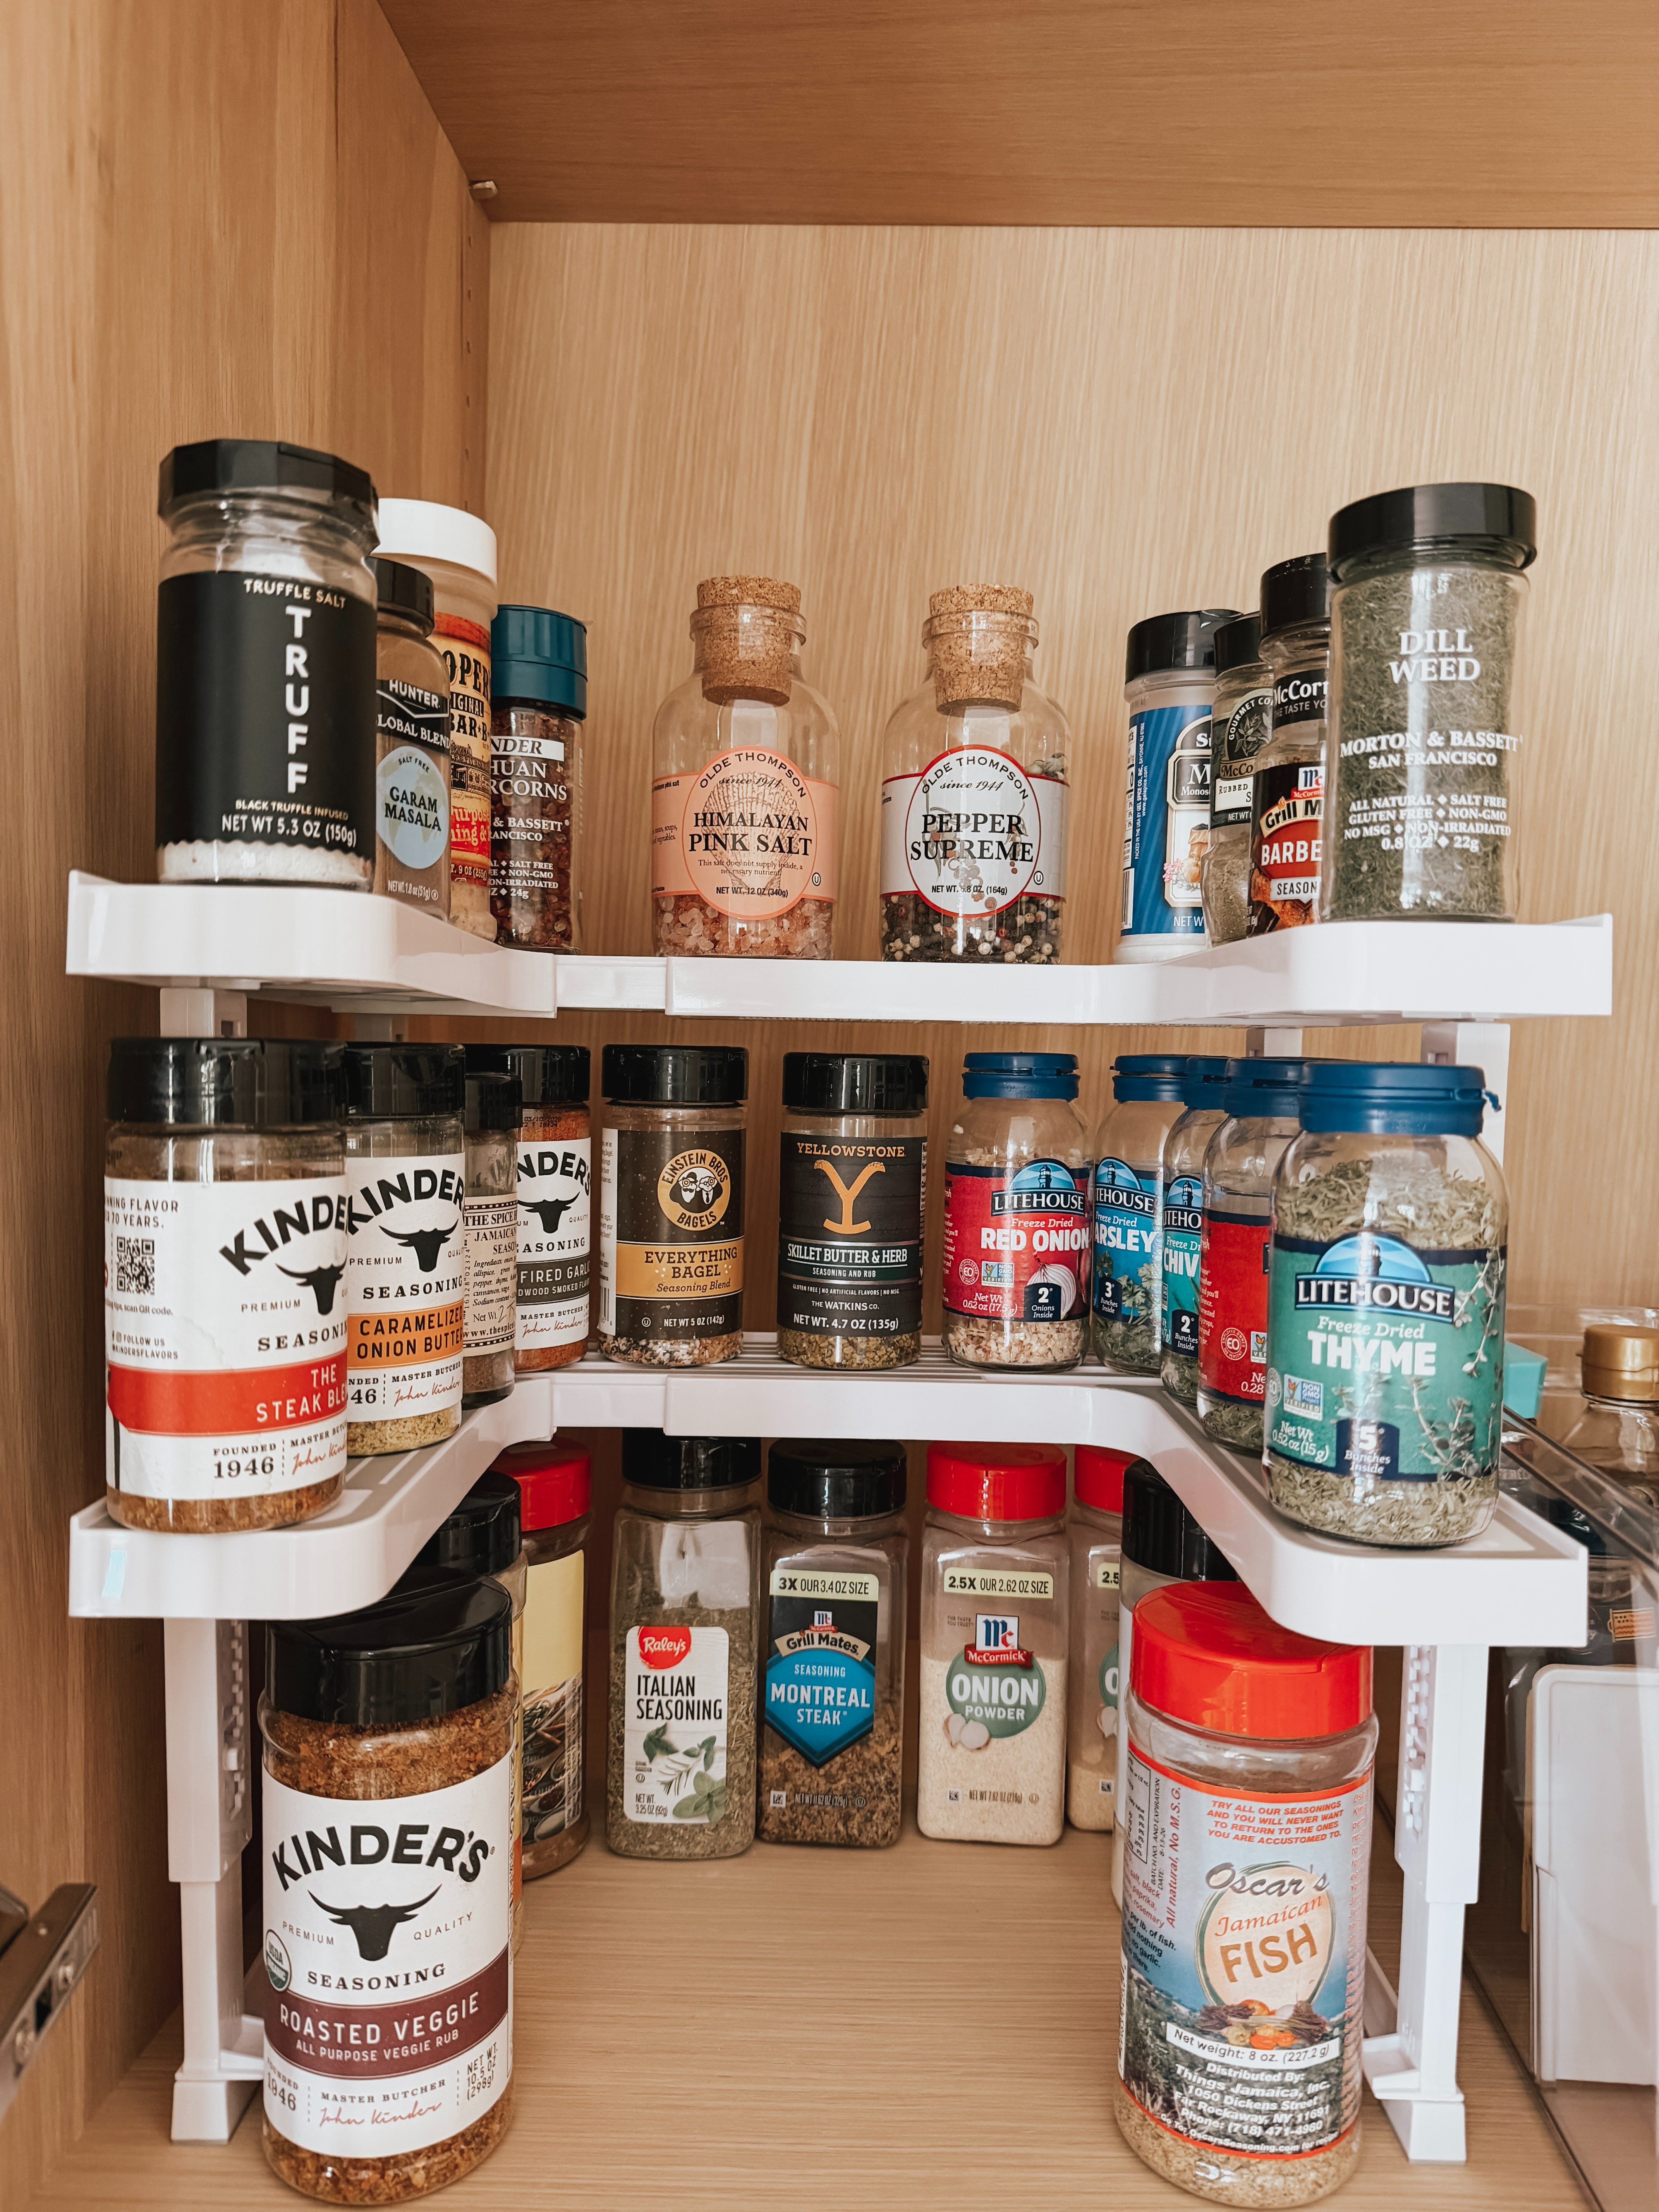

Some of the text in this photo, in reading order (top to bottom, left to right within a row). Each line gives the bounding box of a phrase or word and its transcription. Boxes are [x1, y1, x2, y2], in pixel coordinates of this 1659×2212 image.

[244, 579, 346, 608] TRUFFLE SALT
[1399, 629, 1473, 655] DILL
[1389, 658, 1481, 684] WEED
[389, 680, 438, 708] HUNTER
[1285, 701, 1310, 714] TASTE
[1229, 700, 1255, 740] GOURMET
[1341, 731, 1518, 758] MORTON & BASSETT
[398, 756, 430, 773] SALT FREE
[1369, 751, 1497, 769] SAN FRANCISCO
[700, 752, 806, 798] OLDE THOMPSON
[922, 756, 1028, 800] OLDE THOMPSON
[1219, 783, 1248, 794] RUBBED
[235, 799, 348, 821] BLACK TRUFFLE INFUSED
[390, 786, 437, 813] GARAM
[385, 802, 441, 832] MASALA
[493, 817, 563, 832] & BASSETT
[694, 812, 808, 831] HIMALAYAN
[922, 813, 1024, 834] PEPPER
[1265, 801, 1297, 828] Grill
[689, 833, 812, 856] PINK SALT
[911, 840, 1033, 862] SUPREME
[508, 869, 553, 879] NON-GMO
[779, 861, 798, 870] iodide,
[510, 888, 529, 899] 24g
[768, 888, 788, 898] (340g)
[797, 1143, 905, 1158] YELLOWSTONE
[662, 1153, 728, 1184] EINSTEIN BROS
[131, 1199, 178, 1212] FLAVOR
[995, 1193, 1084, 1211] LITEHOUSE
[465, 1211, 513, 1226] THE SPICE
[677, 1211, 718, 1228] BAGELS
[1011, 1217, 1073, 1228] Freeze Dried
[981, 1227, 1089, 1252] RED ONION
[645, 1247, 737, 1264] EVERYTHING
[788, 1244, 907, 1264] SKILLET BUTTER & HERB
[520, 1267, 562, 1283] FIRED
[672, 1264, 721, 1278] BAGEL
[813, 1267, 876, 1278] SEASONING AND RUB
[363, 1276, 462, 1300] SEASONING
[657, 1279, 730, 1293] Seasoning Blend
[825, 1301, 868, 1311] WATKINS
[1101, 1297, 1118, 1307] Bunches
[1298, 1280, 1450, 1315] LITEHOUSE
[1102, 1304, 1115, 1314] Inside
[359, 1305, 462, 1336] CARAMELIZED
[1317, 1316, 1425, 1339] Freeze Dried
[124, 1333, 165, 1346] FOLLOW US
[357, 1328, 463, 1358] ONION BUTTER
[1175, 1332, 1198, 1344] Bunches
[1177, 1341, 1194, 1351] Inside
[1308, 1331, 1436, 1376] THYME
[311, 1364, 337, 1388] THE
[256, 1393, 321, 1422] STEAK
[213, 1443, 276, 1456] FOUNDED
[1344, 1450, 1390, 1463] Bunches
[213, 1456, 274, 1478] 1946
[1350, 1462, 1383, 1474] Inside
[778, 1577, 869, 1595] 3X OUR 3.4 OZ SIZE
[643, 1636, 686, 1656] Raley's
[967, 1650, 1024, 1662] McCormick
[794, 1664, 845, 1677] SEASONING
[637, 1674, 696, 1697] ITALIAN
[771, 1683, 870, 1708] MONTREAL
[951, 1673, 1038, 1705] ONION
[636, 1699, 722, 1721] SEASONING
[797, 1709, 841, 1725] STEAK
[965, 1705, 1025, 1720] POWDER
[1207, 1809, 1344, 1825] AND YOU WILL NEVER WANT
[1212, 1800, 1232, 1809] TRY
[1235, 1805, 1254, 1813] ALL
[1284, 1801, 1341, 1815] SEASONINGS
[272, 1824, 489, 1892] KINDER'S
[1166, 1787, 1181, 1929] All natural, No M.S.G.
[1206, 1862, 1329, 1896] Oscar's
[1214, 1895, 1323, 1936] Jamaican
[282, 1912, 473, 1946] PREMIUM QUALITY
[1220, 1922, 1317, 1983] FISH
[307, 1962, 447, 1991] SEASONING
[280, 1991, 479, 2045] ROASTED VEGGIE
[297, 2029, 459, 2061] ALL PURPOSE VEGGIE RUB
[1176, 2064, 1331, 2098] Things Jamaica, Inc.
[1206, 2063, 1305, 2083] Distributed By:
[1187, 2084, 1318, 2111] 1050 Dickens Street
